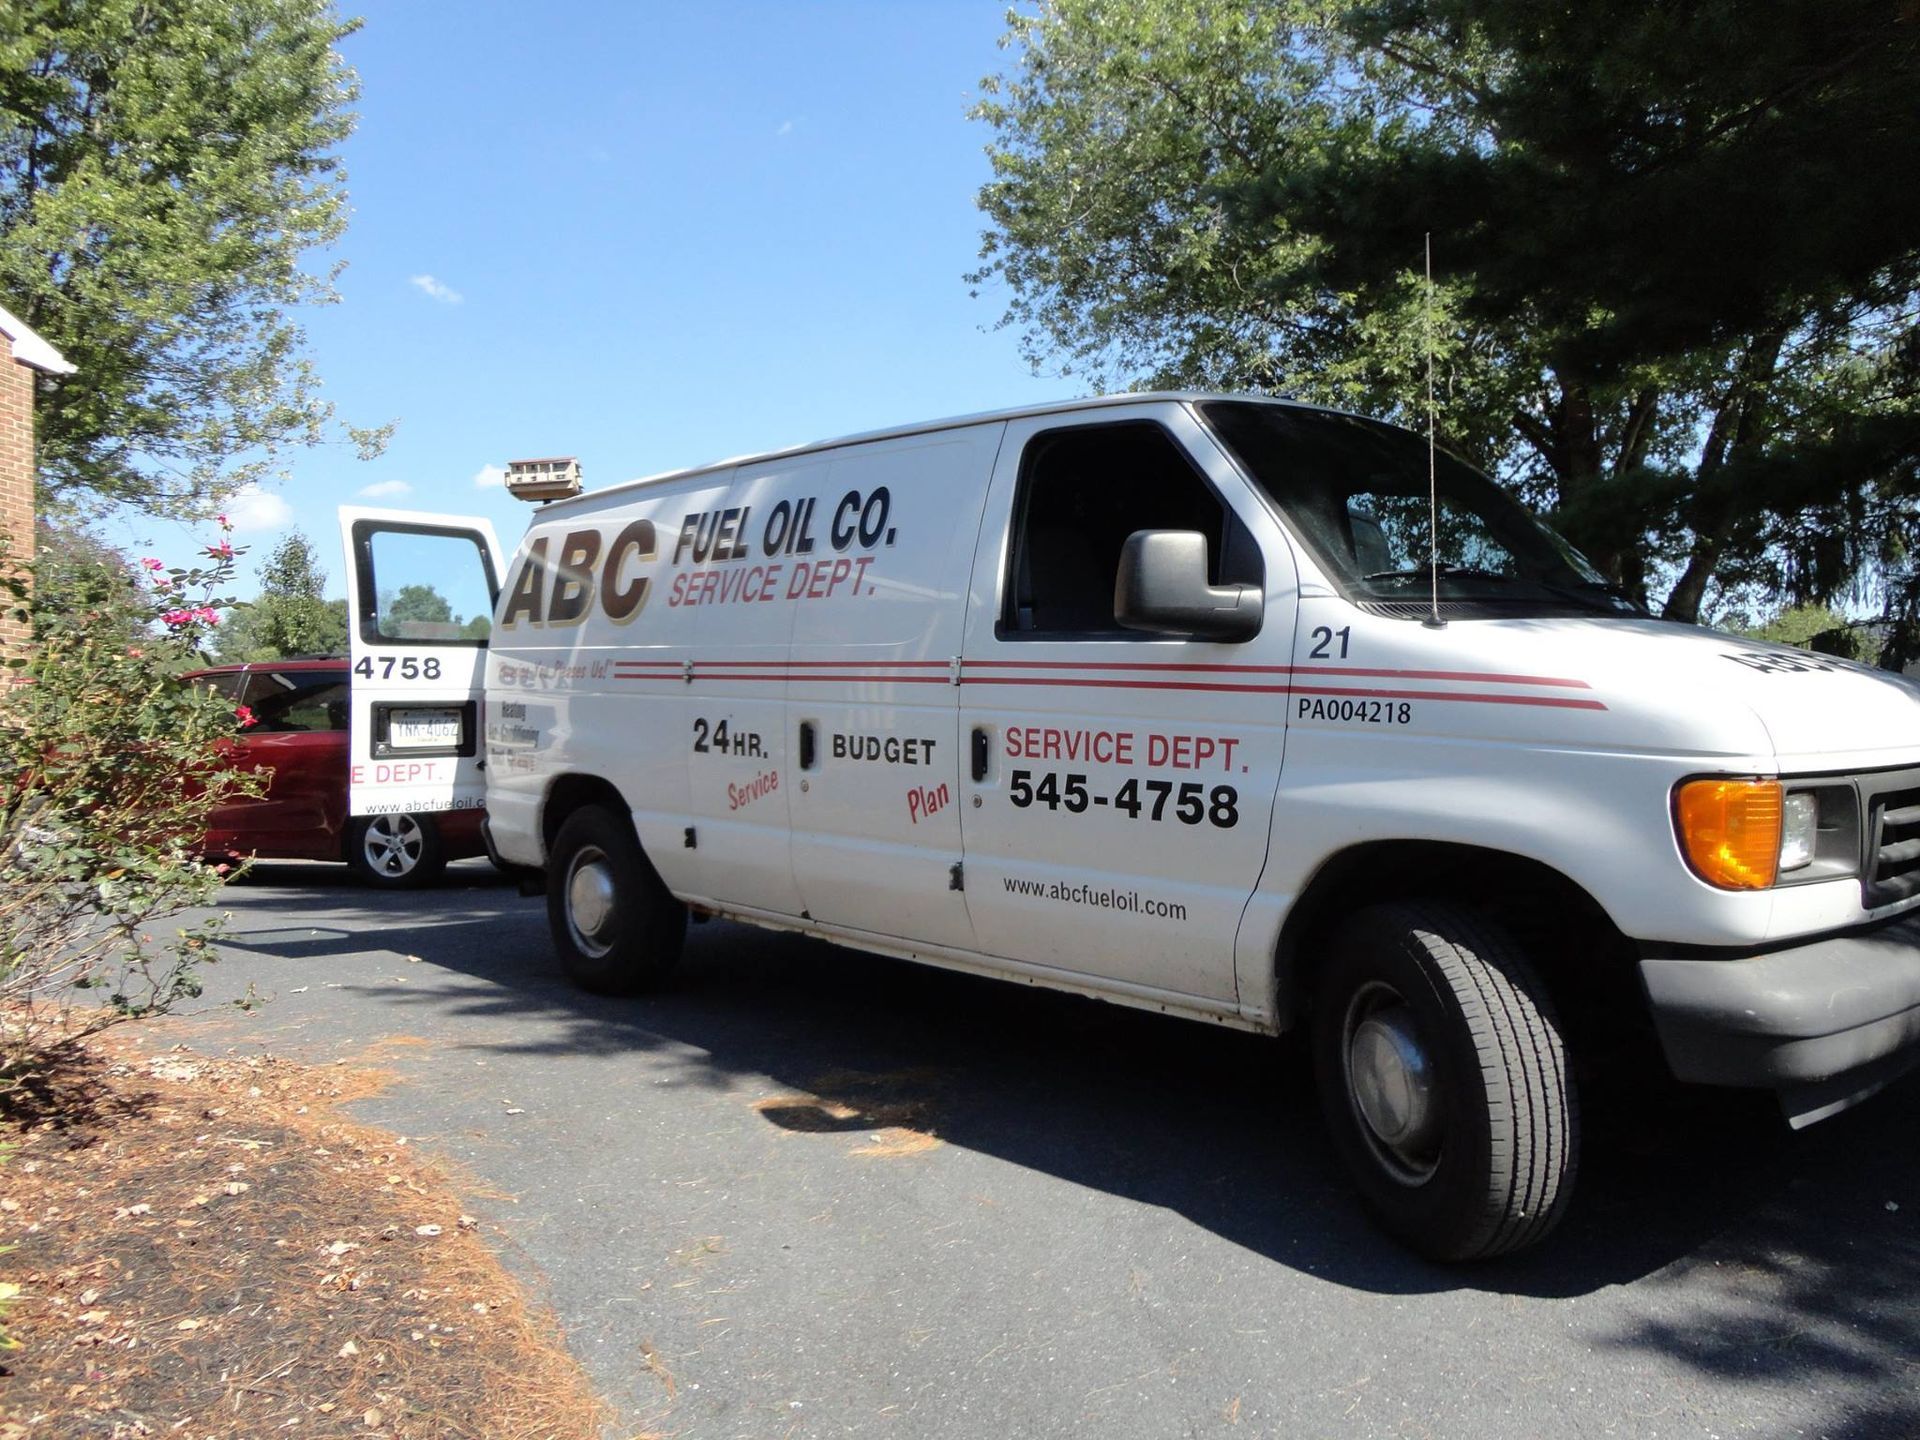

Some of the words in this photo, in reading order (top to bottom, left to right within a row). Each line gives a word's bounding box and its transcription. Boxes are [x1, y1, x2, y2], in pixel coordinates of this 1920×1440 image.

[672, 506, 752, 566] FUEL
[763, 496, 816, 558] OIL
[831, 486, 897, 551] CO.
[502, 518, 658, 630] ABC
[668, 564, 783, 608] SERVICE
[786, 556, 876, 601] DEPT.
[1309, 625, 1350, 659] 21
[353, 656, 441, 680] 4758
[1298, 698, 1411, 724] PA004218
[832, 733, 936, 765] BUDGET
[1006, 726, 1134, 765] SERVICE
[1147, 733, 1249, 773] DEPT.
[375, 762, 443, 783] DEPT.
[728, 770, 779, 811] Service
[906, 782, 950, 824] Plan
[1009, 769, 1239, 829] 545-4758
[1003, 877, 1187, 920] www.abcfueloil.com
